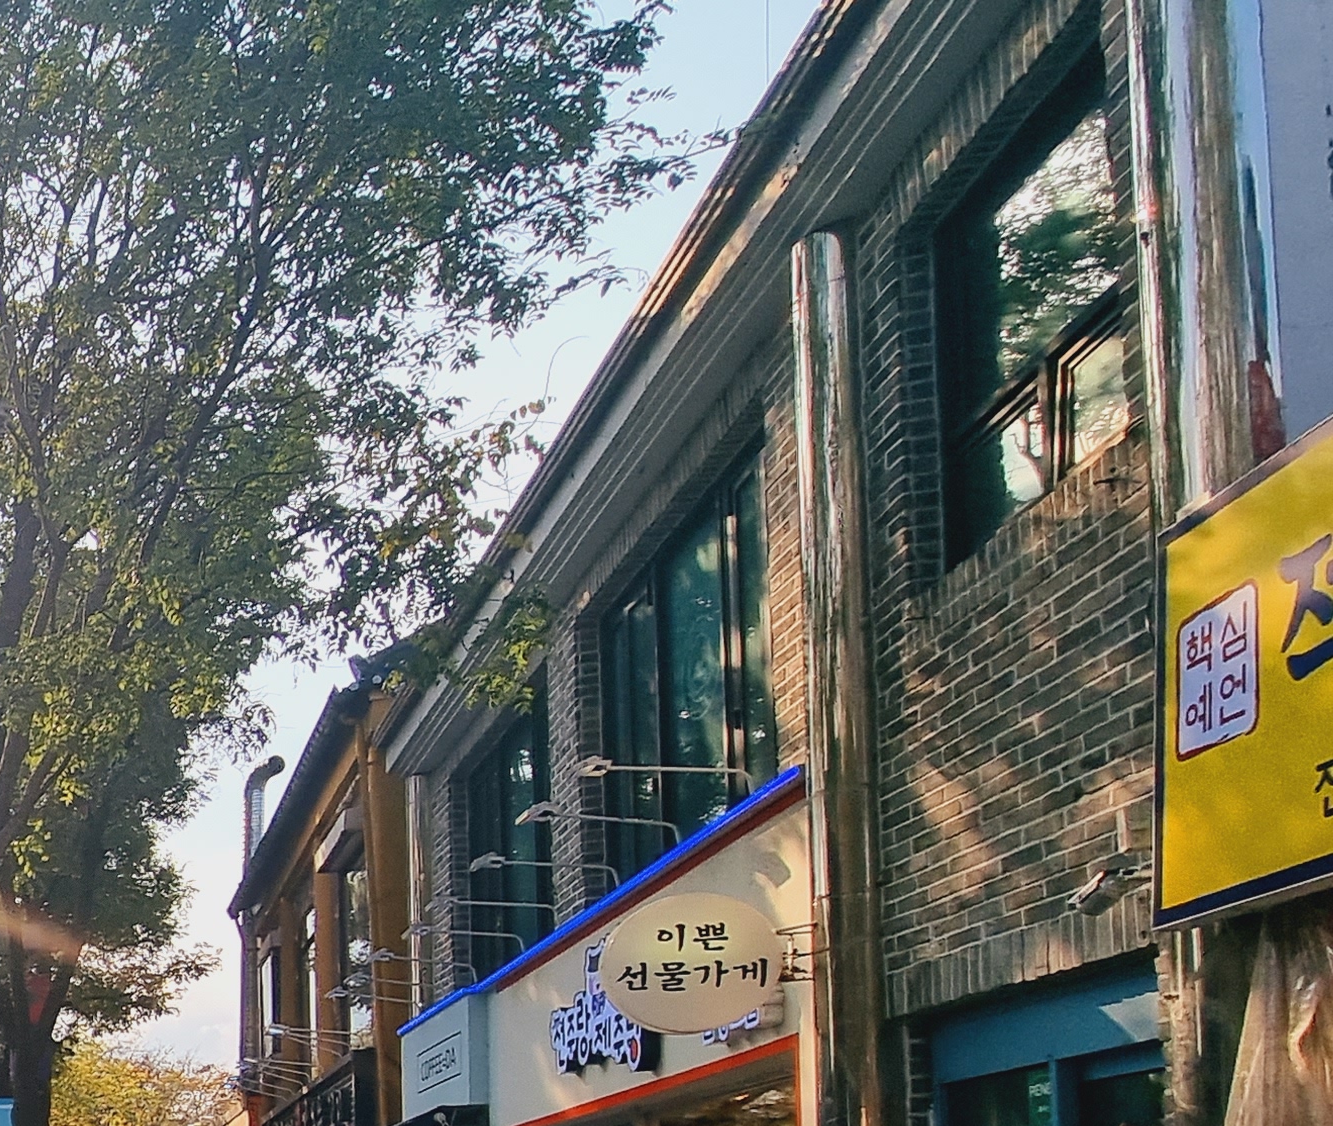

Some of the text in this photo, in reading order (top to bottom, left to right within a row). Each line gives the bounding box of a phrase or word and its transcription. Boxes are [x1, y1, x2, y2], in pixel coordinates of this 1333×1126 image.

[1185, 600, 1247, 672] 핵심
[1185, 663, 1247, 733] 예언
[657, 922, 729, 952] 이쁜
[616, 957, 768, 992] 선물가게
